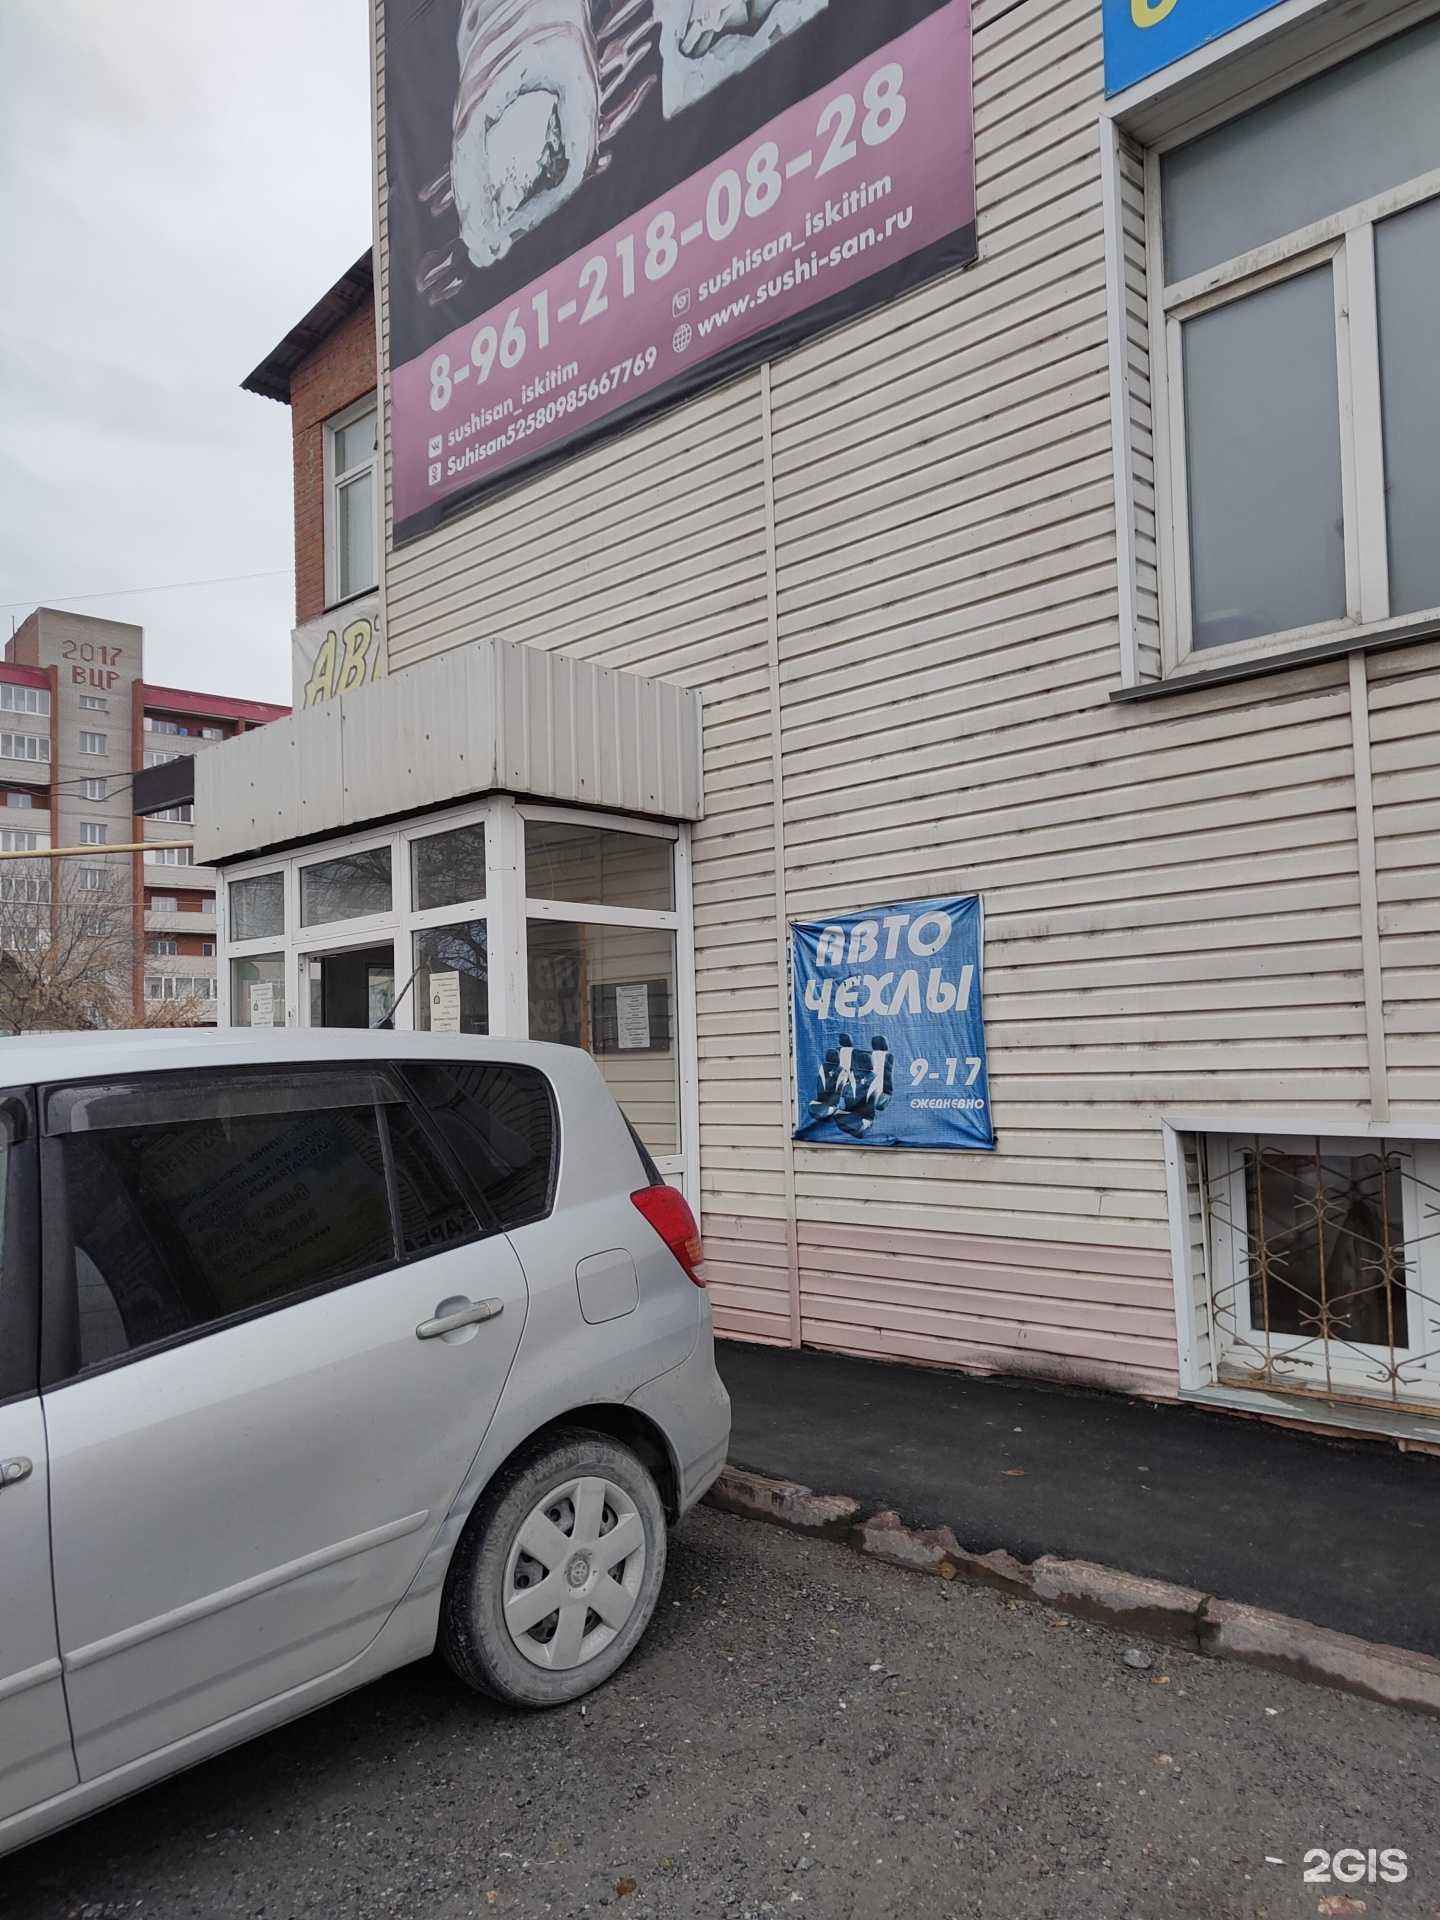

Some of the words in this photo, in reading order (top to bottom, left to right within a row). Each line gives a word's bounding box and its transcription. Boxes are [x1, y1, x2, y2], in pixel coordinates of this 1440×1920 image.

[428, 63, 908, 412] 8-961-218-08-28
[697, 206, 913, 337] www.sushi-san.ru
[698, 175, 892, 302] sushisan_iskitim
[447, 361, 579, 447] sushisan_iskitim
[62, 639, 123, 666] 2017
[303, 614, 381, 709] АВ
[815, 911, 953, 967] АВТО
[805, 965, 974, 1020] ЧЕХЛЫ
[909, 1057, 982, 1087] 9-17
